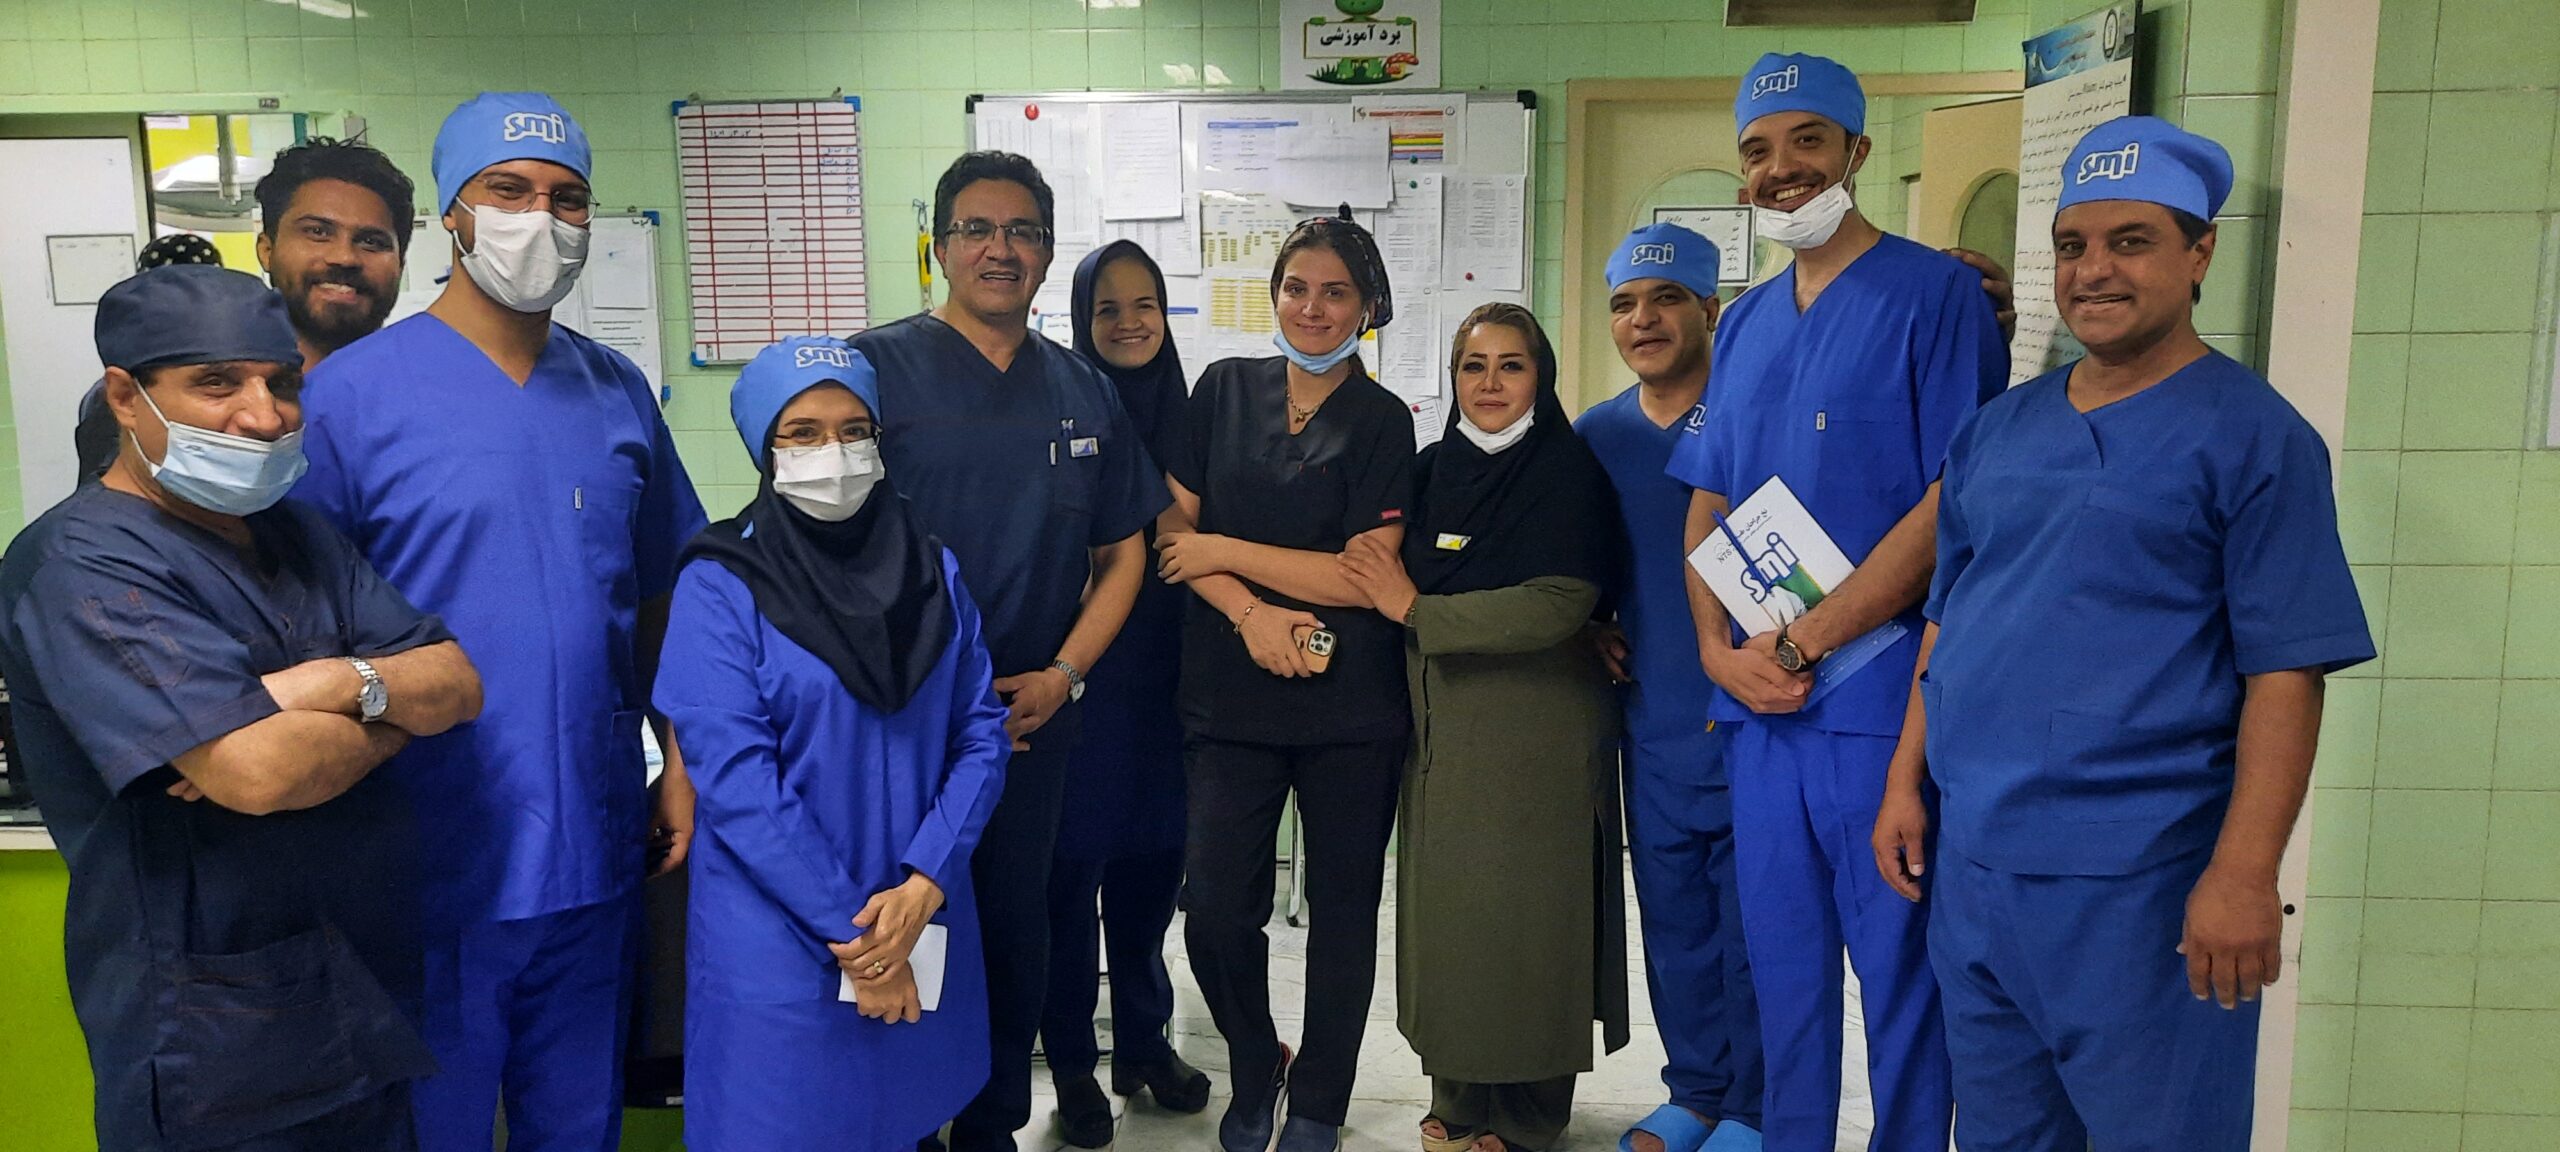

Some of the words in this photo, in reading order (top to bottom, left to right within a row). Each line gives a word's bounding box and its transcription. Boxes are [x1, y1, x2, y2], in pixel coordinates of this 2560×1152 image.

[1320, 24, 1376, 46] آموزشی
[1380, 29, 1402, 46] برد
[1751, 65, 1799, 100] smi
[503, 112, 566, 144] smi
[2076, 142, 2139, 185] smi
[1631, 243, 1674, 266] smi
[794, 346, 852, 368] smi
[1740, 532, 1800, 604] smi
